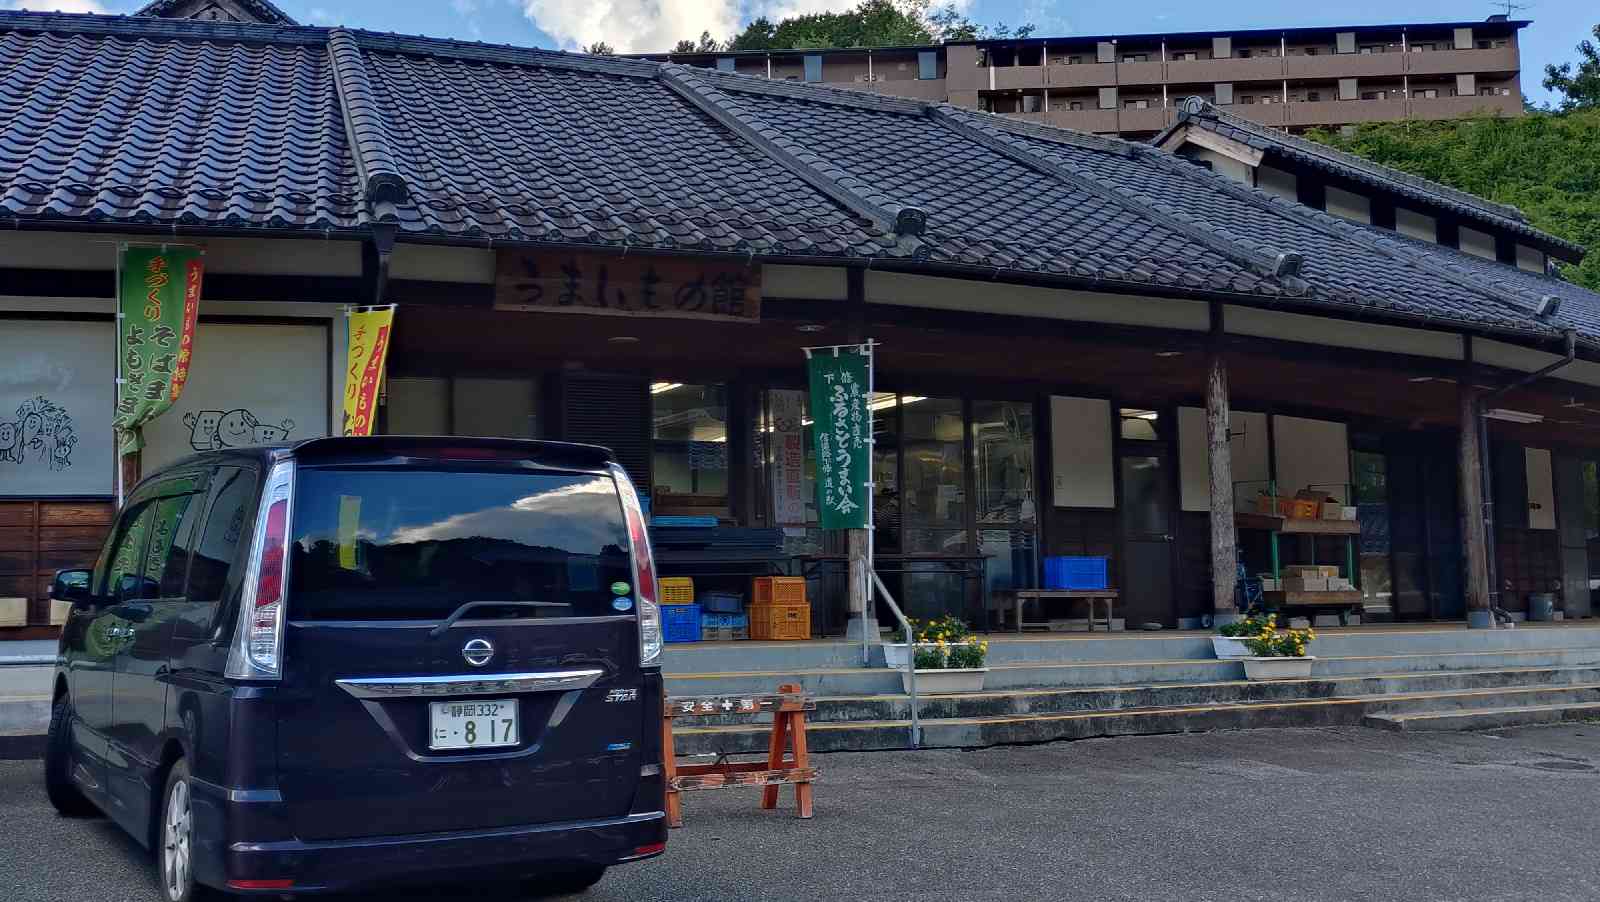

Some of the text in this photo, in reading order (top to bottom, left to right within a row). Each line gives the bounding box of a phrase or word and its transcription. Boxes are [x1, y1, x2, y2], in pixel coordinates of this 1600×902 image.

[515, 257, 751, 315] うまいもの館
